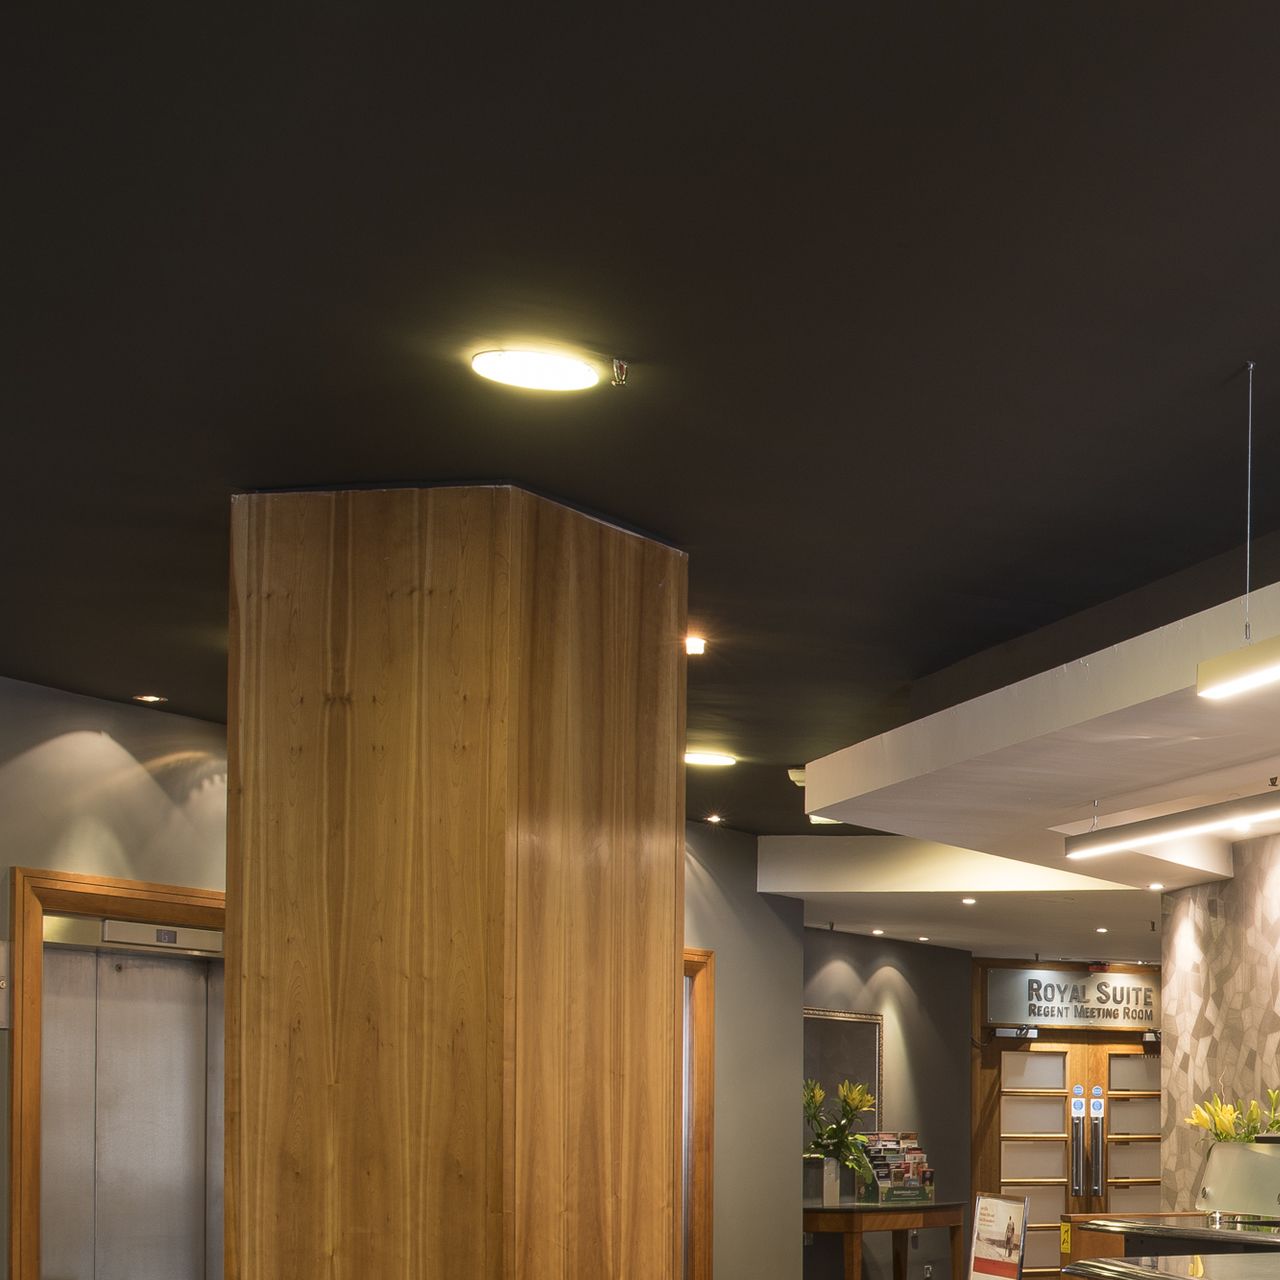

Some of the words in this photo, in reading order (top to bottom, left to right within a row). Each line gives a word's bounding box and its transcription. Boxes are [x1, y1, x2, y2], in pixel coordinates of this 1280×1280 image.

[1027, 978, 1090, 1004] ROYAL
[1096, 981, 1153, 1006] SUITE
[1028, 1003, 1070, 1018] REGENT
[1074, 1005, 1119, 1020] MEETING
[1122, 1006, 1153, 1021] ROOM
